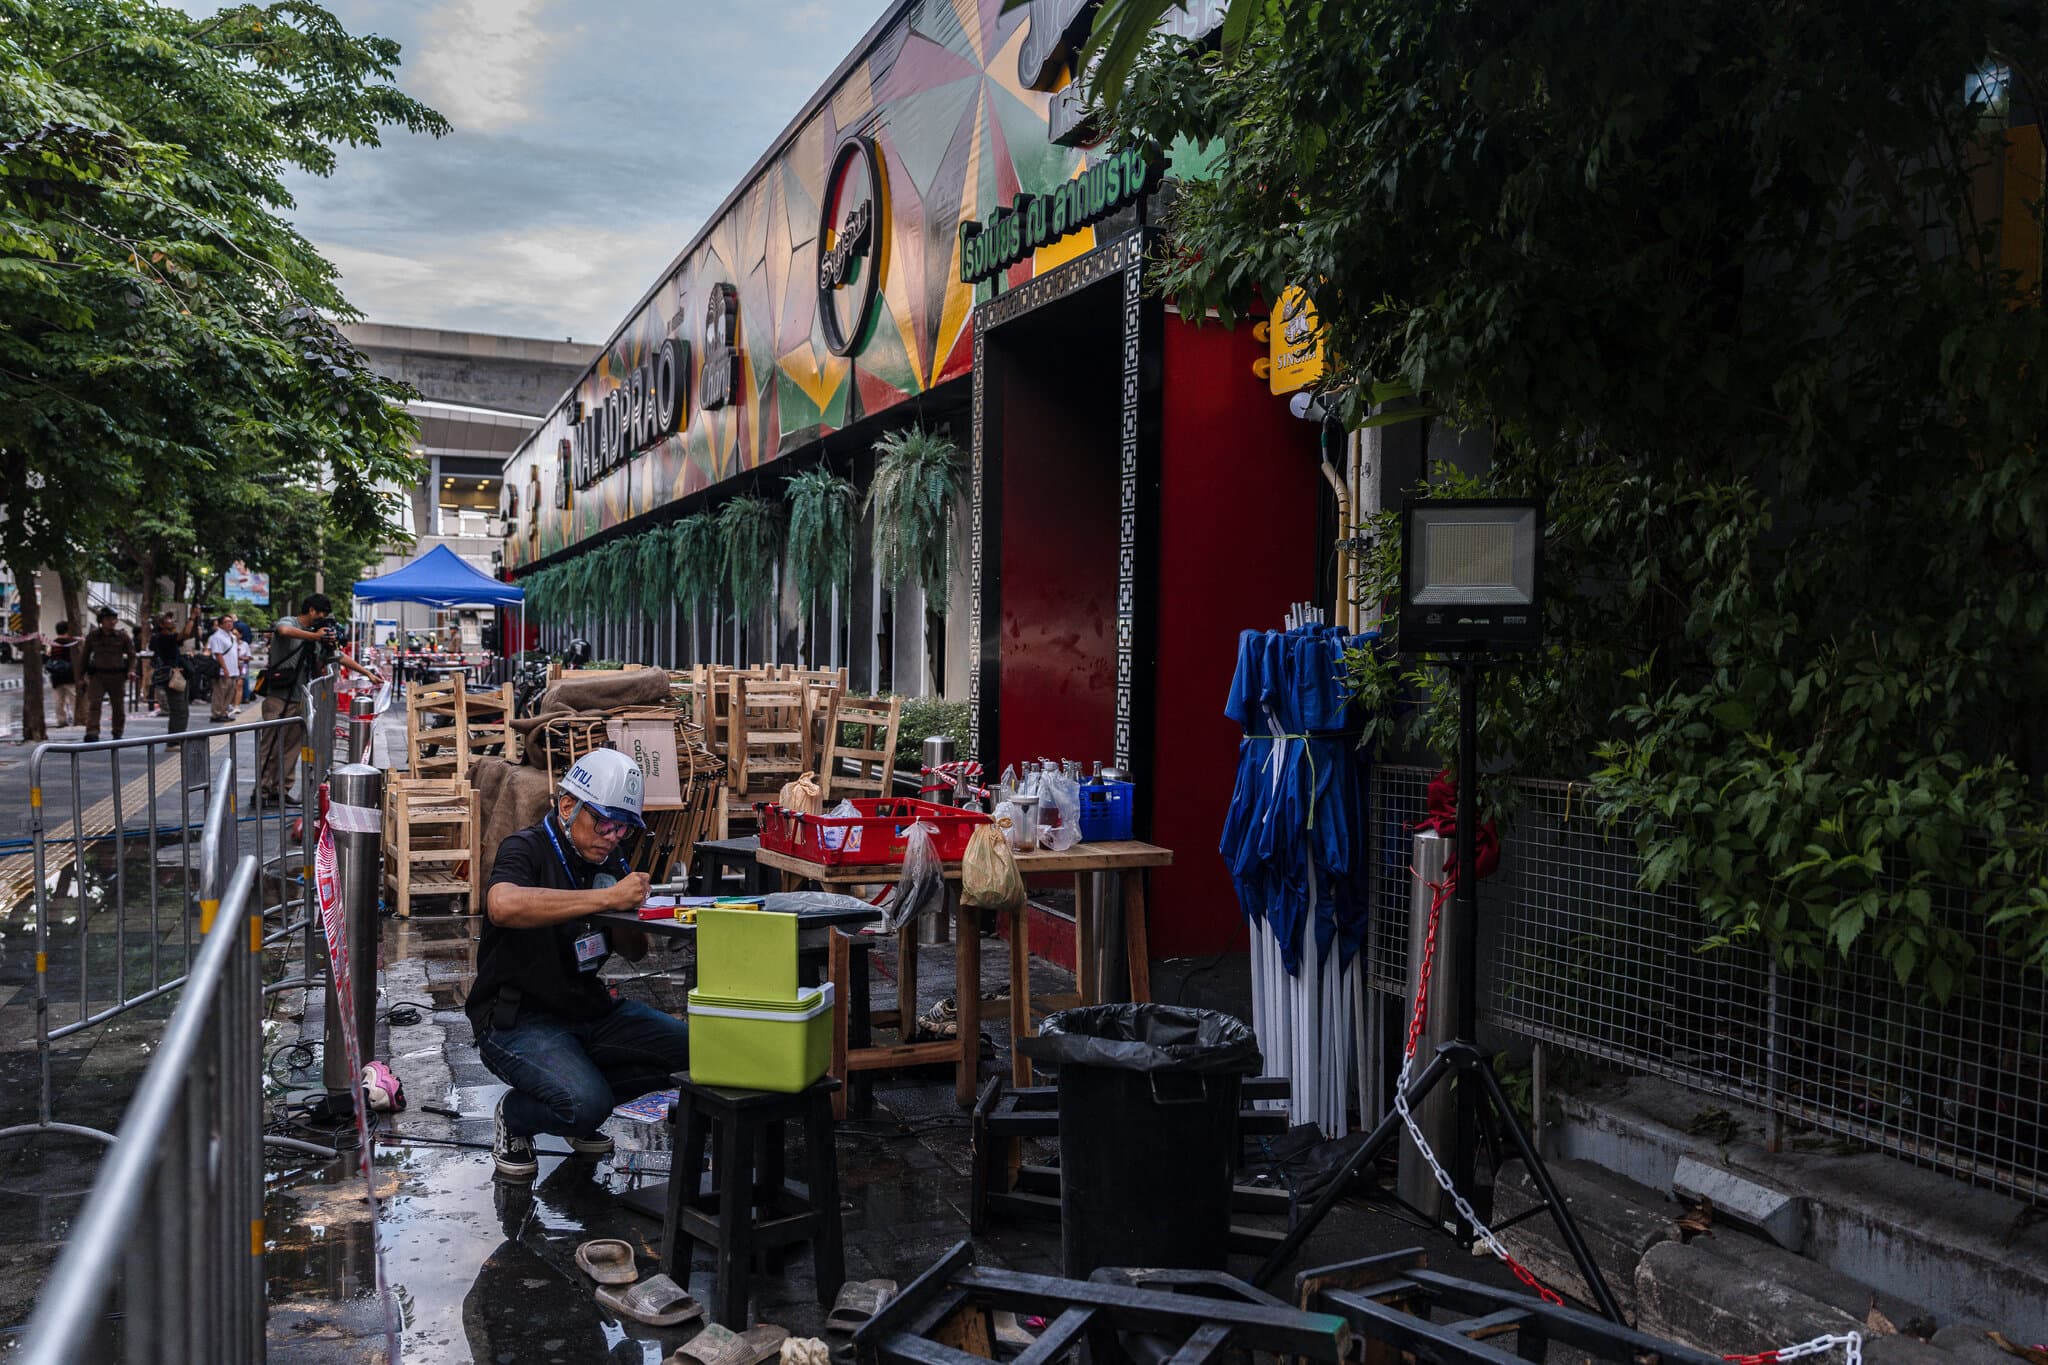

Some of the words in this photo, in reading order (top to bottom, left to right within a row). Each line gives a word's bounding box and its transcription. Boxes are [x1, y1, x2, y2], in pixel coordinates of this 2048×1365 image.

[1026, 196, 1046, 248] ณ
[1053, 142, 1147, 235] ลาดพราว
[700, 357, 731, 410] Chang
[634, 739, 642, 762] COLD
[652, 751, 660, 777] Chang
